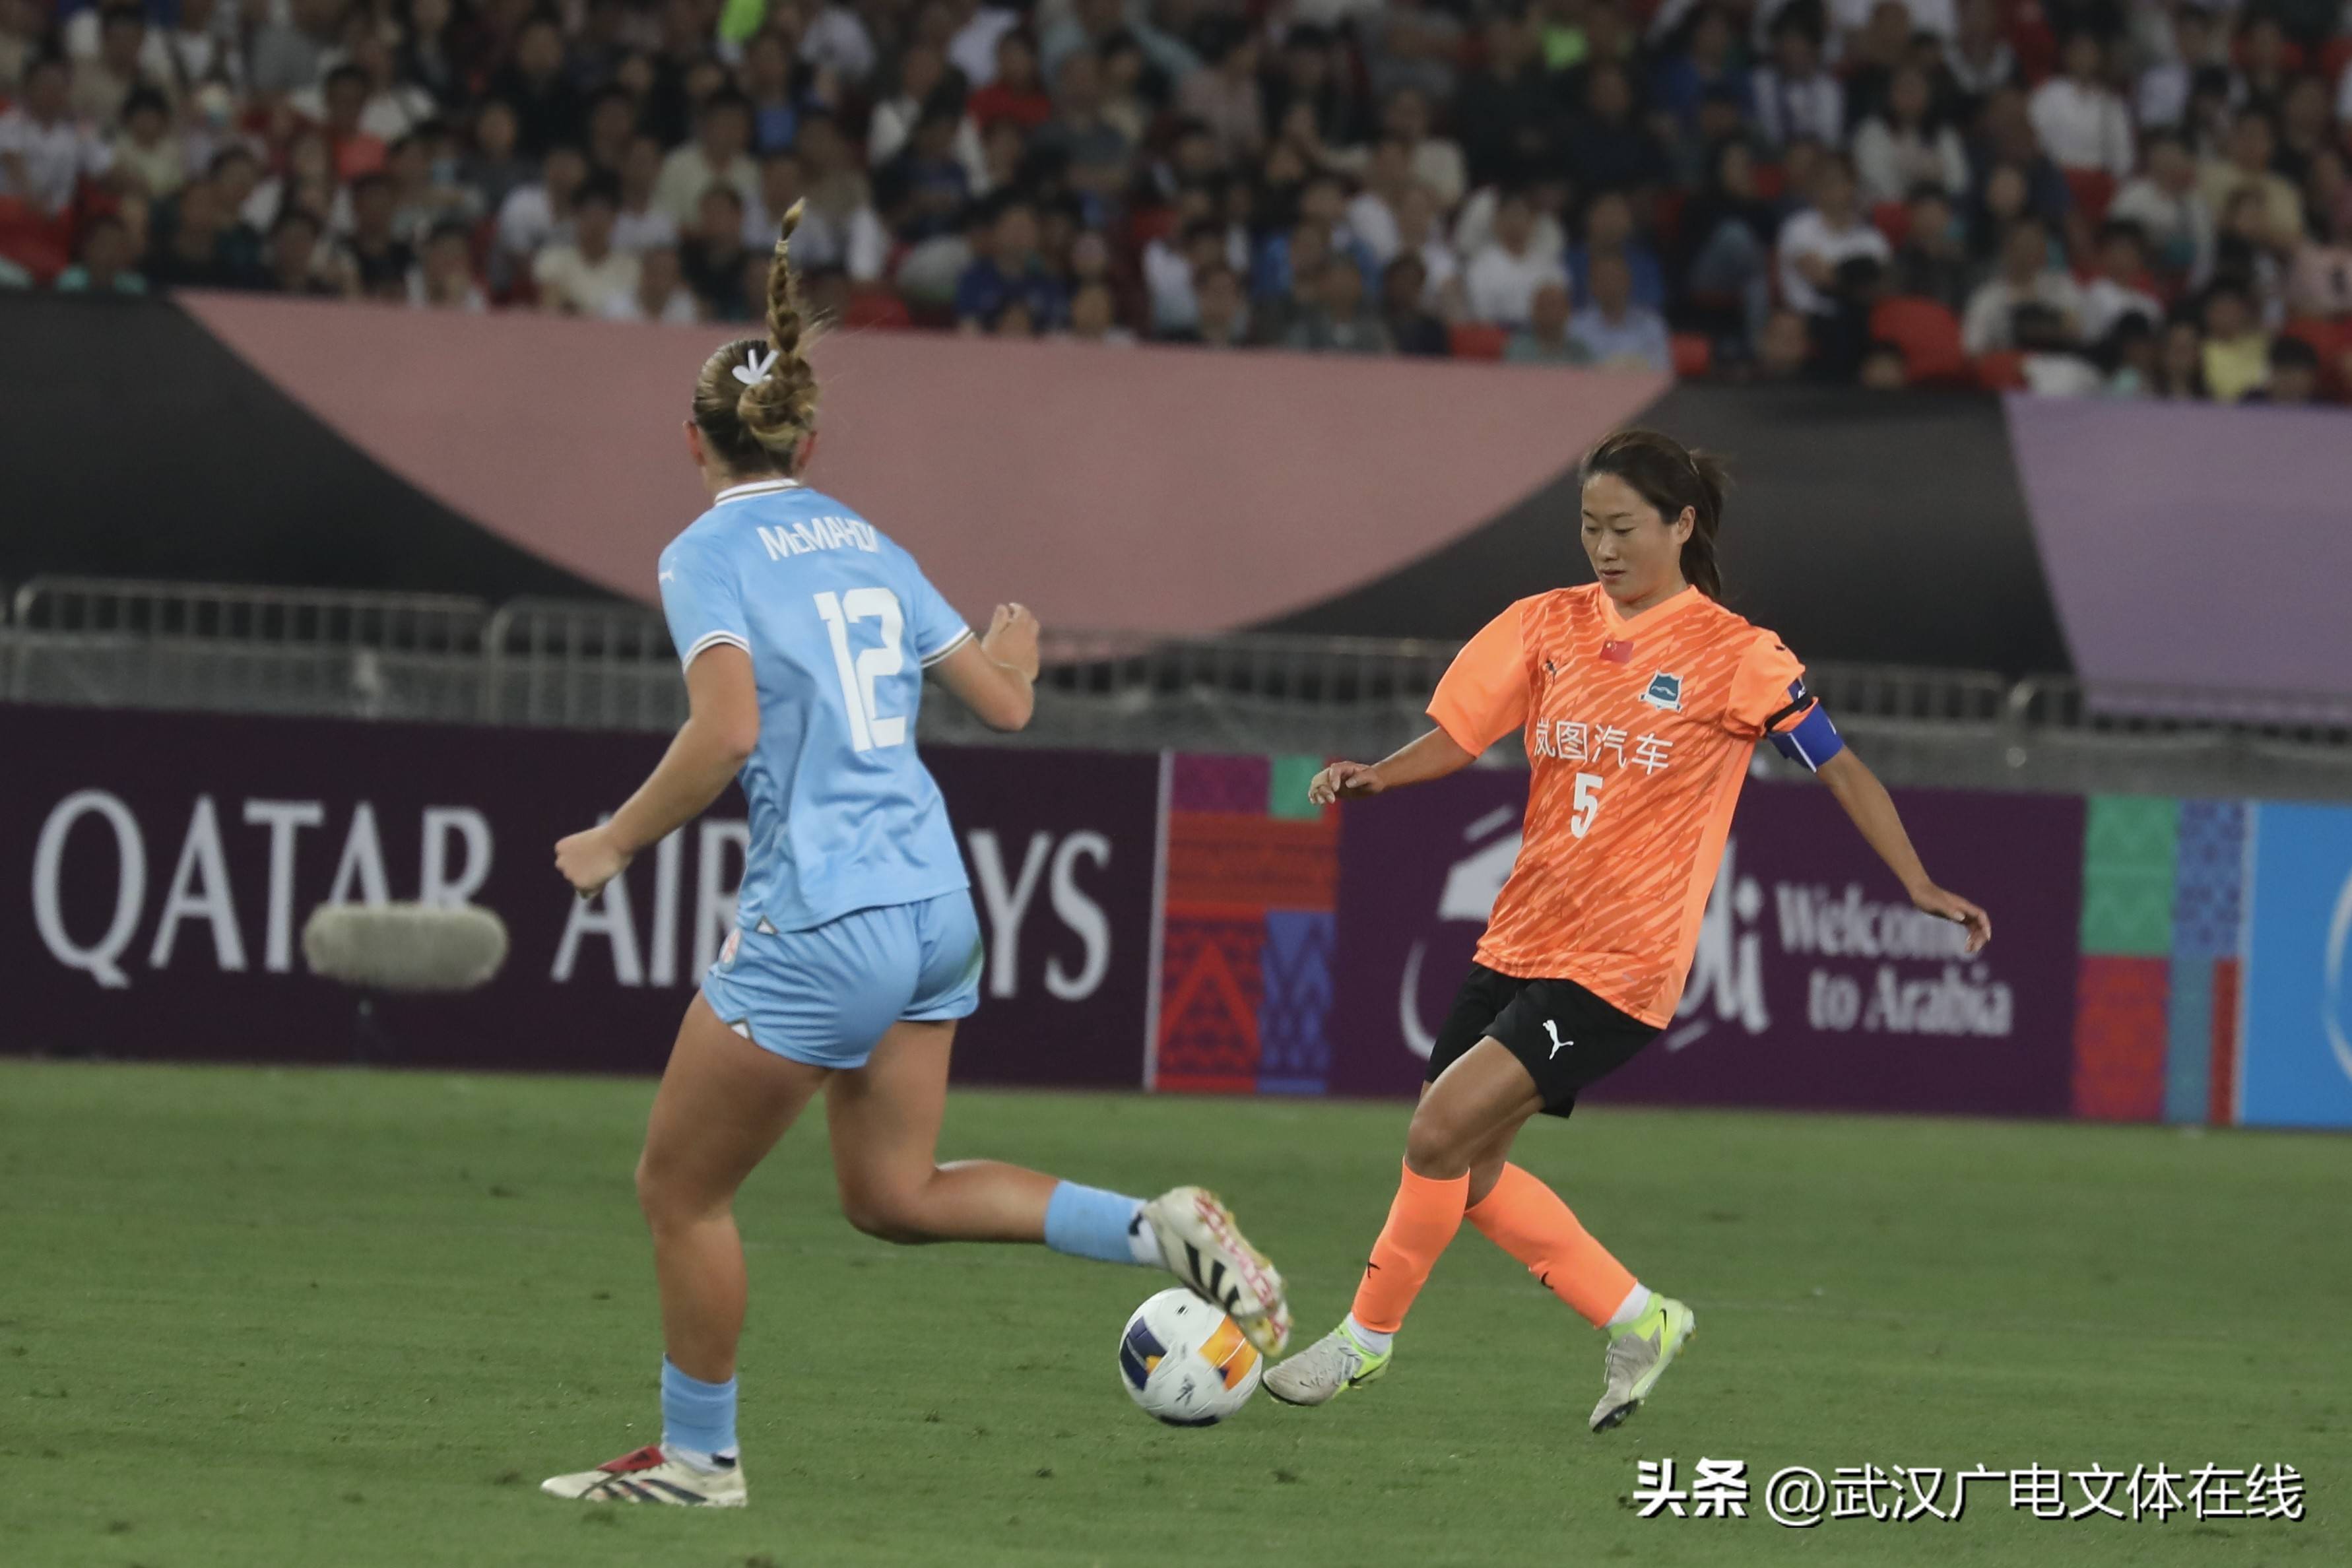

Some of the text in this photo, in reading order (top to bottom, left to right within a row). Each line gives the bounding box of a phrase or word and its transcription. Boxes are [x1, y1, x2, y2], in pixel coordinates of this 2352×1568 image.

[813, 587, 906, 752] 12
[1534, 716, 1674, 775] 岚图汽车
[1571, 772, 1604, 839] 5
[31, 788, 1111, 1002] QATAR AIRYS
[1775, 880, 1979, 962] Welcom
[1808, 962, 2013, 1037] to Arabia
